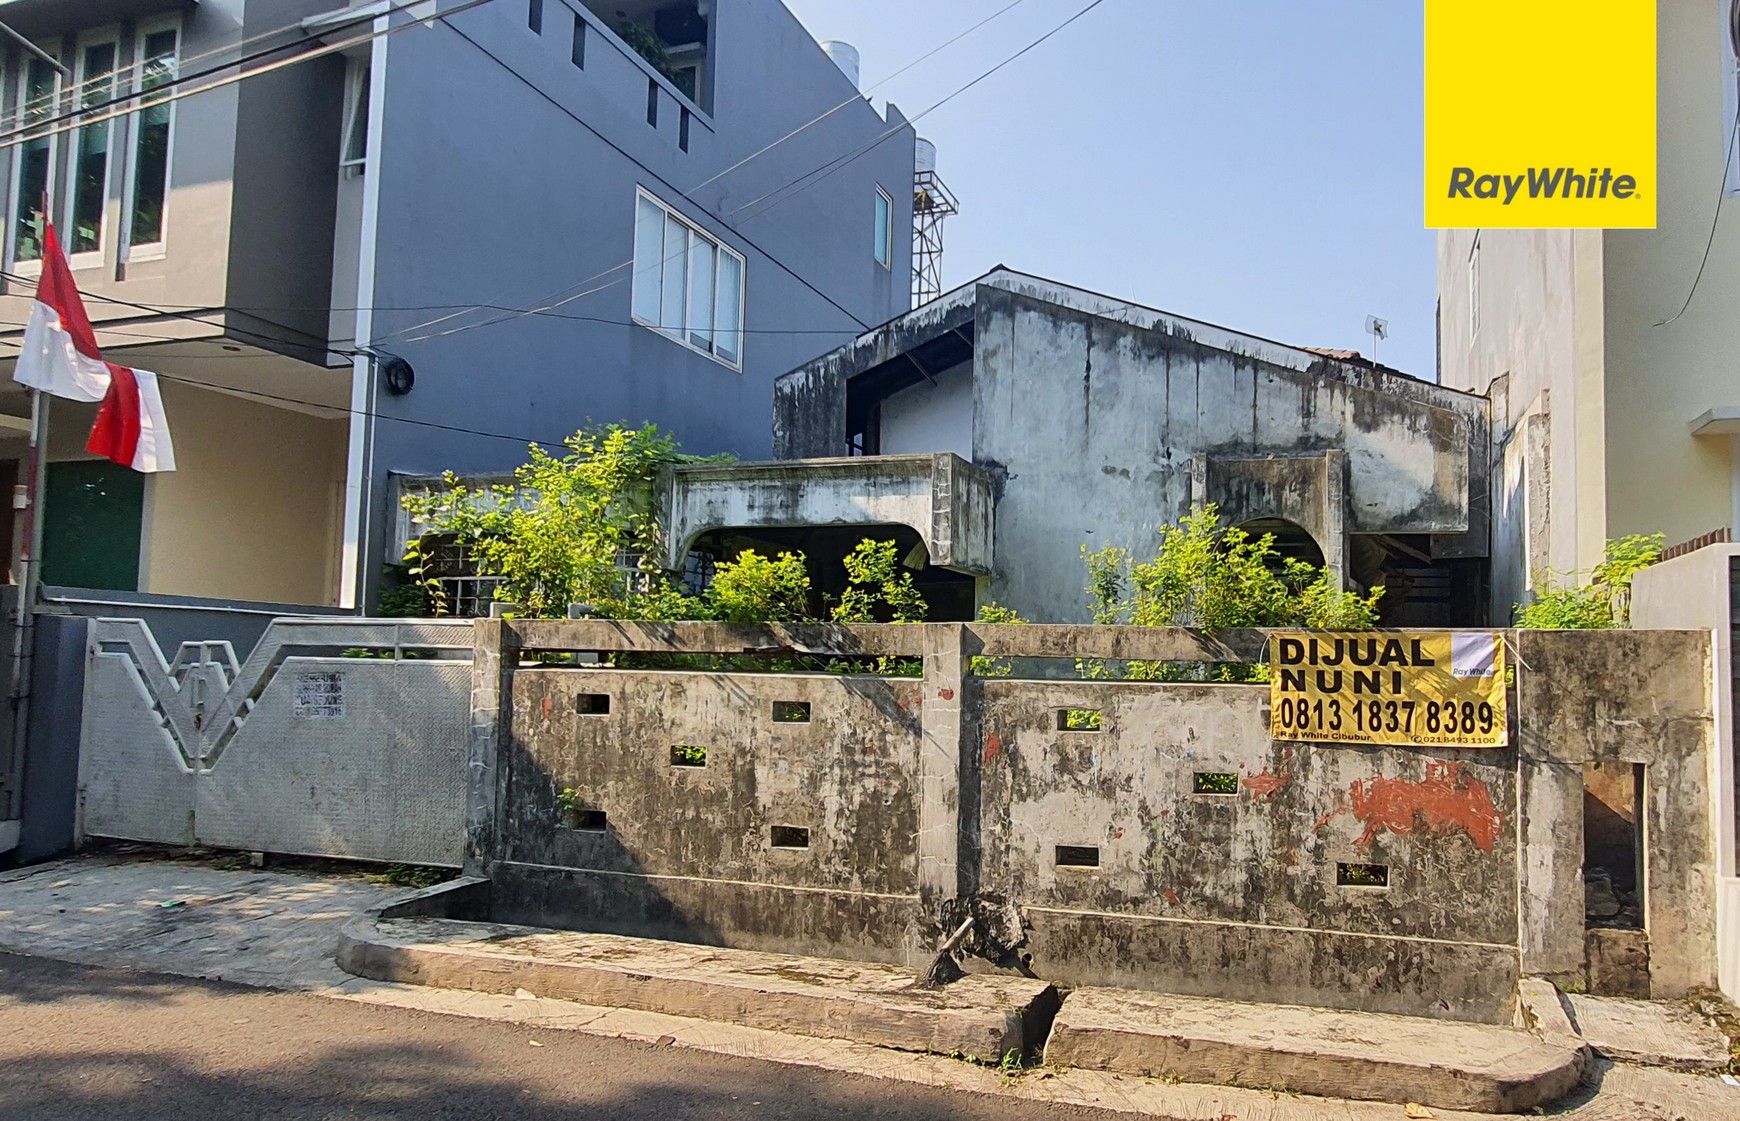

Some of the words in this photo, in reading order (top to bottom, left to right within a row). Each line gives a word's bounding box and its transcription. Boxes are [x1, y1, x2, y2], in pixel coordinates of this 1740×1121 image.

[1279, 639, 1435, 667] DIJUAL
[1280, 669, 1402, 694] NUNI
[1453, 668, 1468, 676] Ray
[1281, 698, 1342, 730] 0813
[1352, 700, 1415, 732] 1837
[1426, 701, 1493, 734] 8389
[1331, 733, 1371, 741] Cibubur
